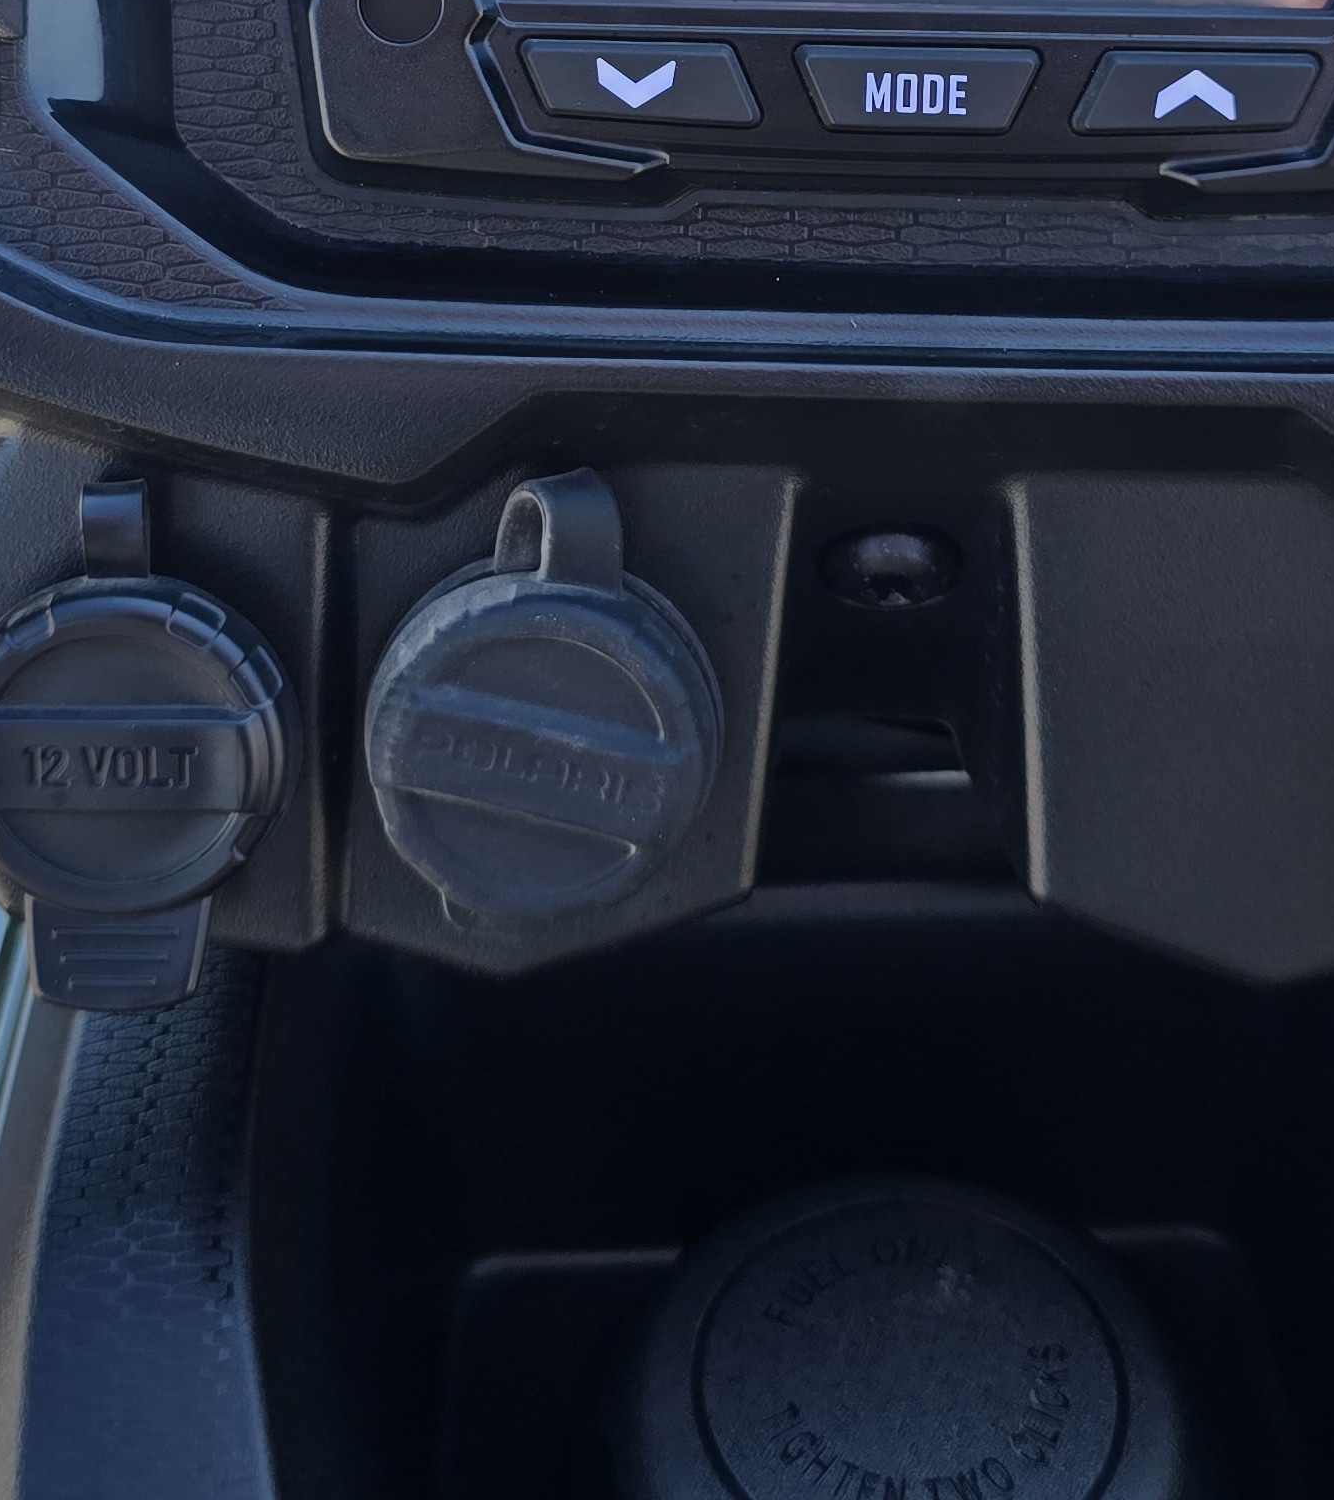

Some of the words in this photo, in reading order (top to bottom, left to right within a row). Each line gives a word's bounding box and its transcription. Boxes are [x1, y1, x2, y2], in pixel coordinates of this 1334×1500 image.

[865, 71, 968, 116] MODE
[21, 745, 72, 789] 12
[79, 745, 199, 790] VOLT
[762, 1250, 857, 1329] FUEL
[869, 1234, 996, 1280] ONLY
